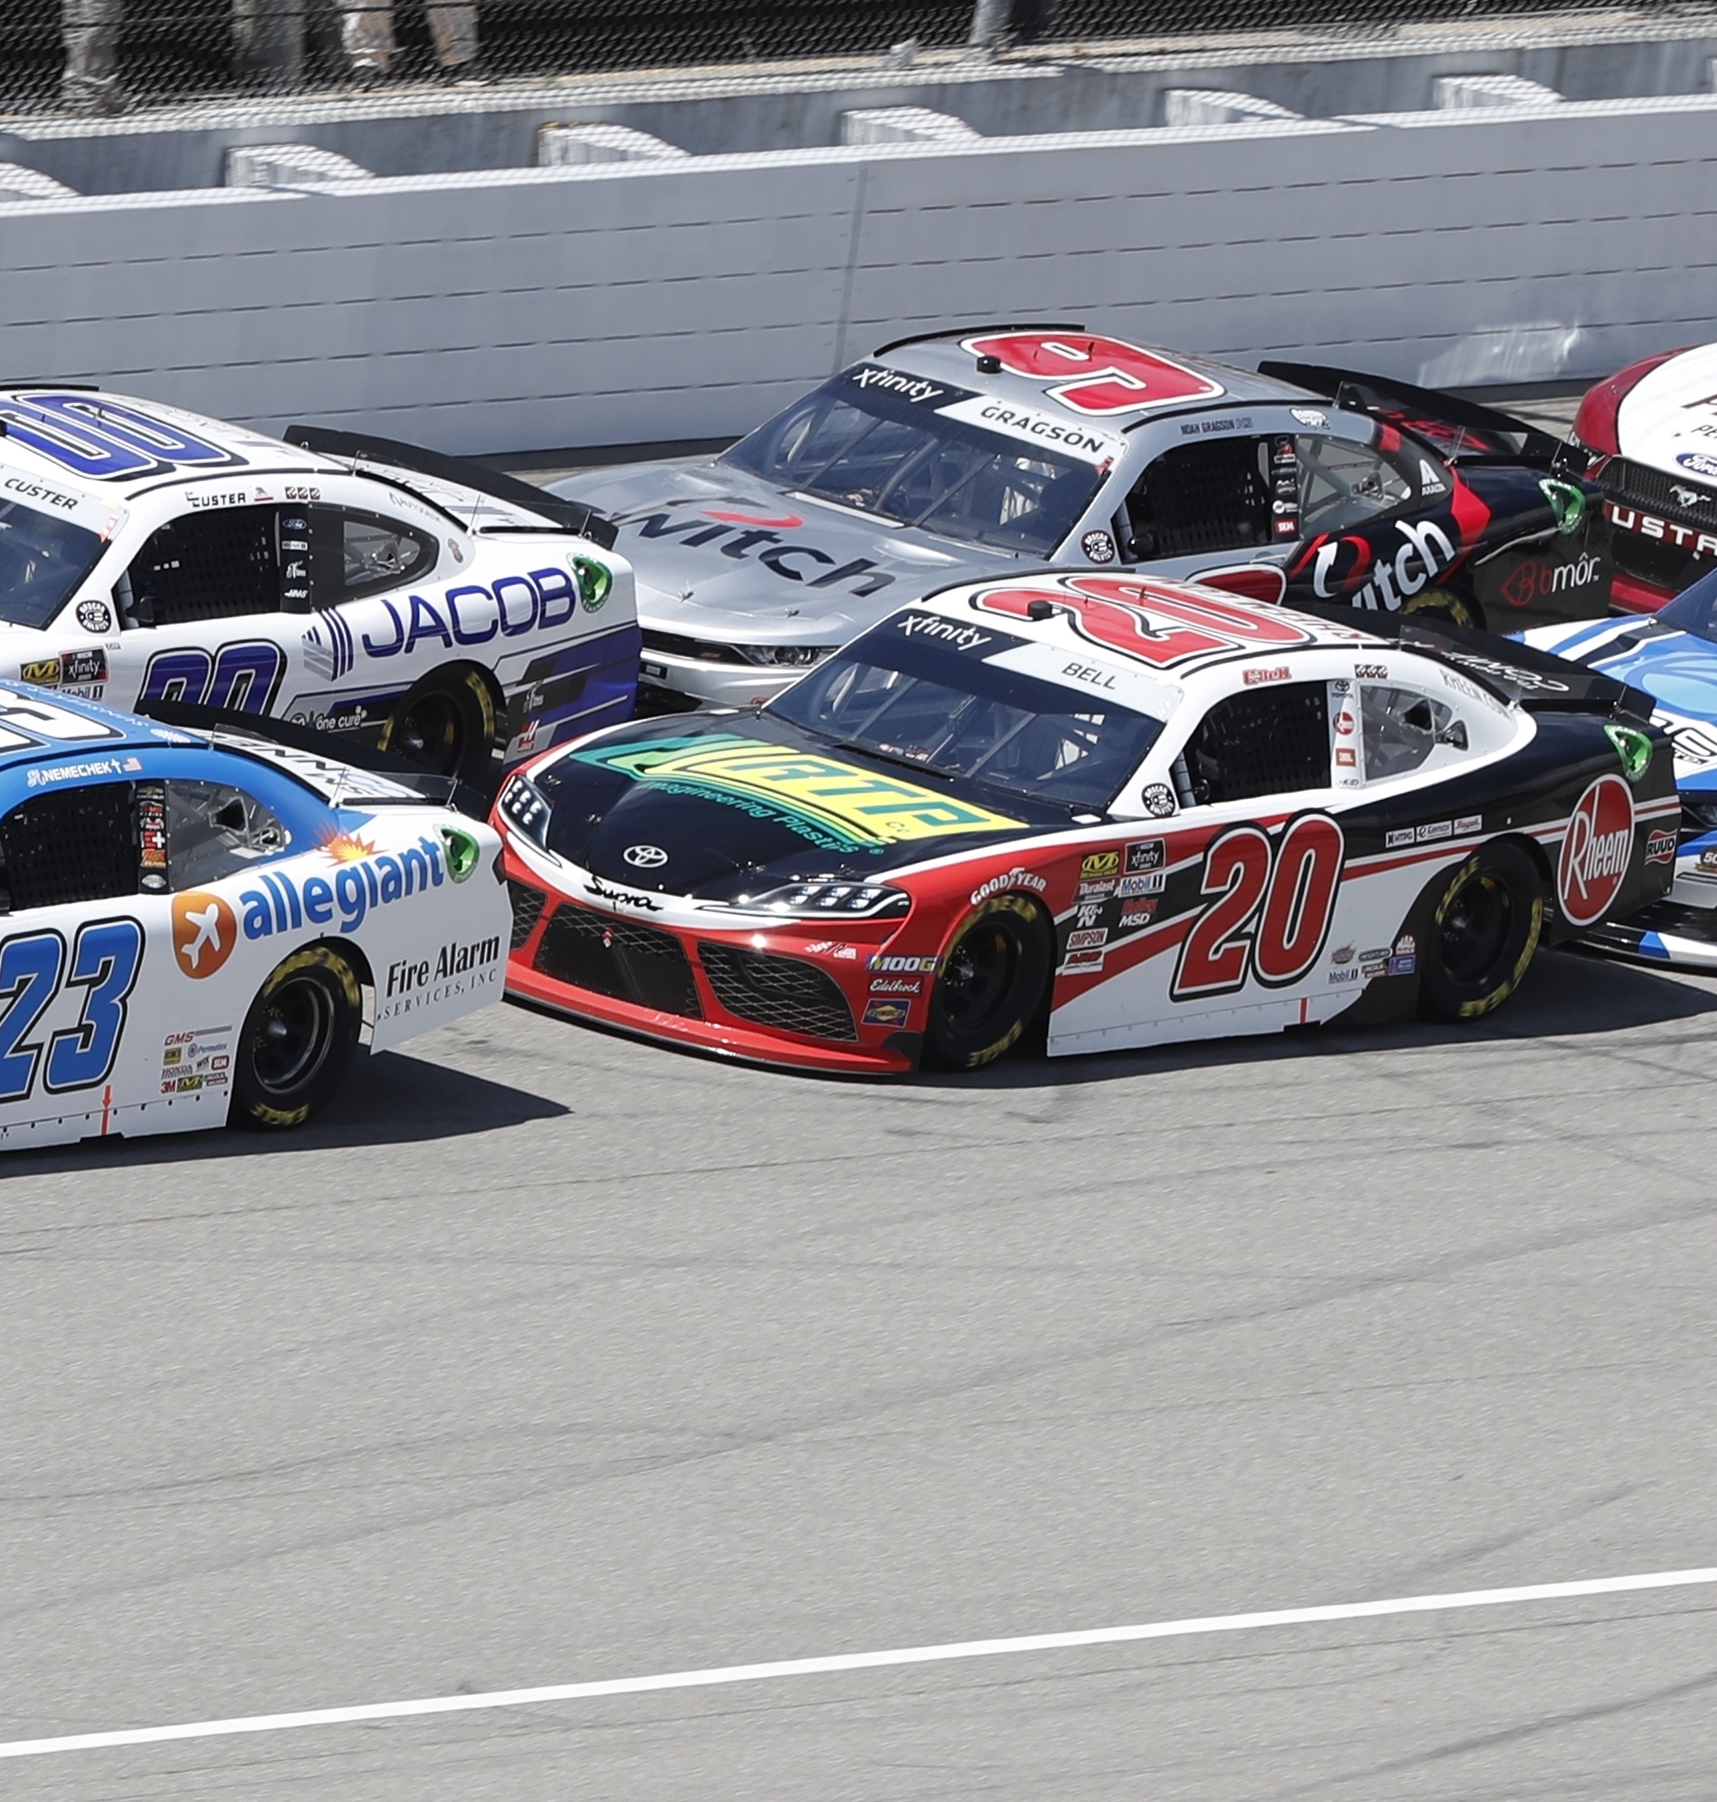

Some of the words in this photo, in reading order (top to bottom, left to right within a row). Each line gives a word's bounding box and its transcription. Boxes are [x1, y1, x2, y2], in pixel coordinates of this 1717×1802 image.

[852, 368, 944, 402] xfinity
[980, 406, 1106, 454] GRAGSON
[3, 478, 79, 511] CUSTER
[607, 512, 896, 598] witch
[362, 568, 576, 657] JACOB
[969, 574, 1317, 669] 20
[897, 612, 992, 651] xfinity
[68, 660, 100, 678] xfinity
[1061, 662, 1117, 691] BELL
[43, 760, 112, 783] NEMECHEK
[636, 780, 777, 819] Imagineering
[1564, 784, 1629, 900] Rheem
[1646, 838, 1674, 857] RUUD
[1131, 851, 1160, 868] xfinity
[239, 836, 444, 941] allegiant
[583, 874, 664, 912] Supra
[970, 867, 1046, 905] GOODYEAR
[1079, 879, 1115, 896] Duralast
[1122, 879, 1151, 893] Mobil
[1118, 912, 1150, 928] MSD
[1169, 808, 1344, 1003] 20
[1069, 930, 1107, 949] SIMPSON
[386, 960, 429, 998] Fire
[433, 936, 500, 982] Alarm
[869, 956, 936, 973] MOOG
[384, 980, 465, 1019] SERVICES,
[470, 969, 497, 990] INC
[869, 978, 921, 993] Edelbrock
[164, 1031, 195, 1046] GMS
